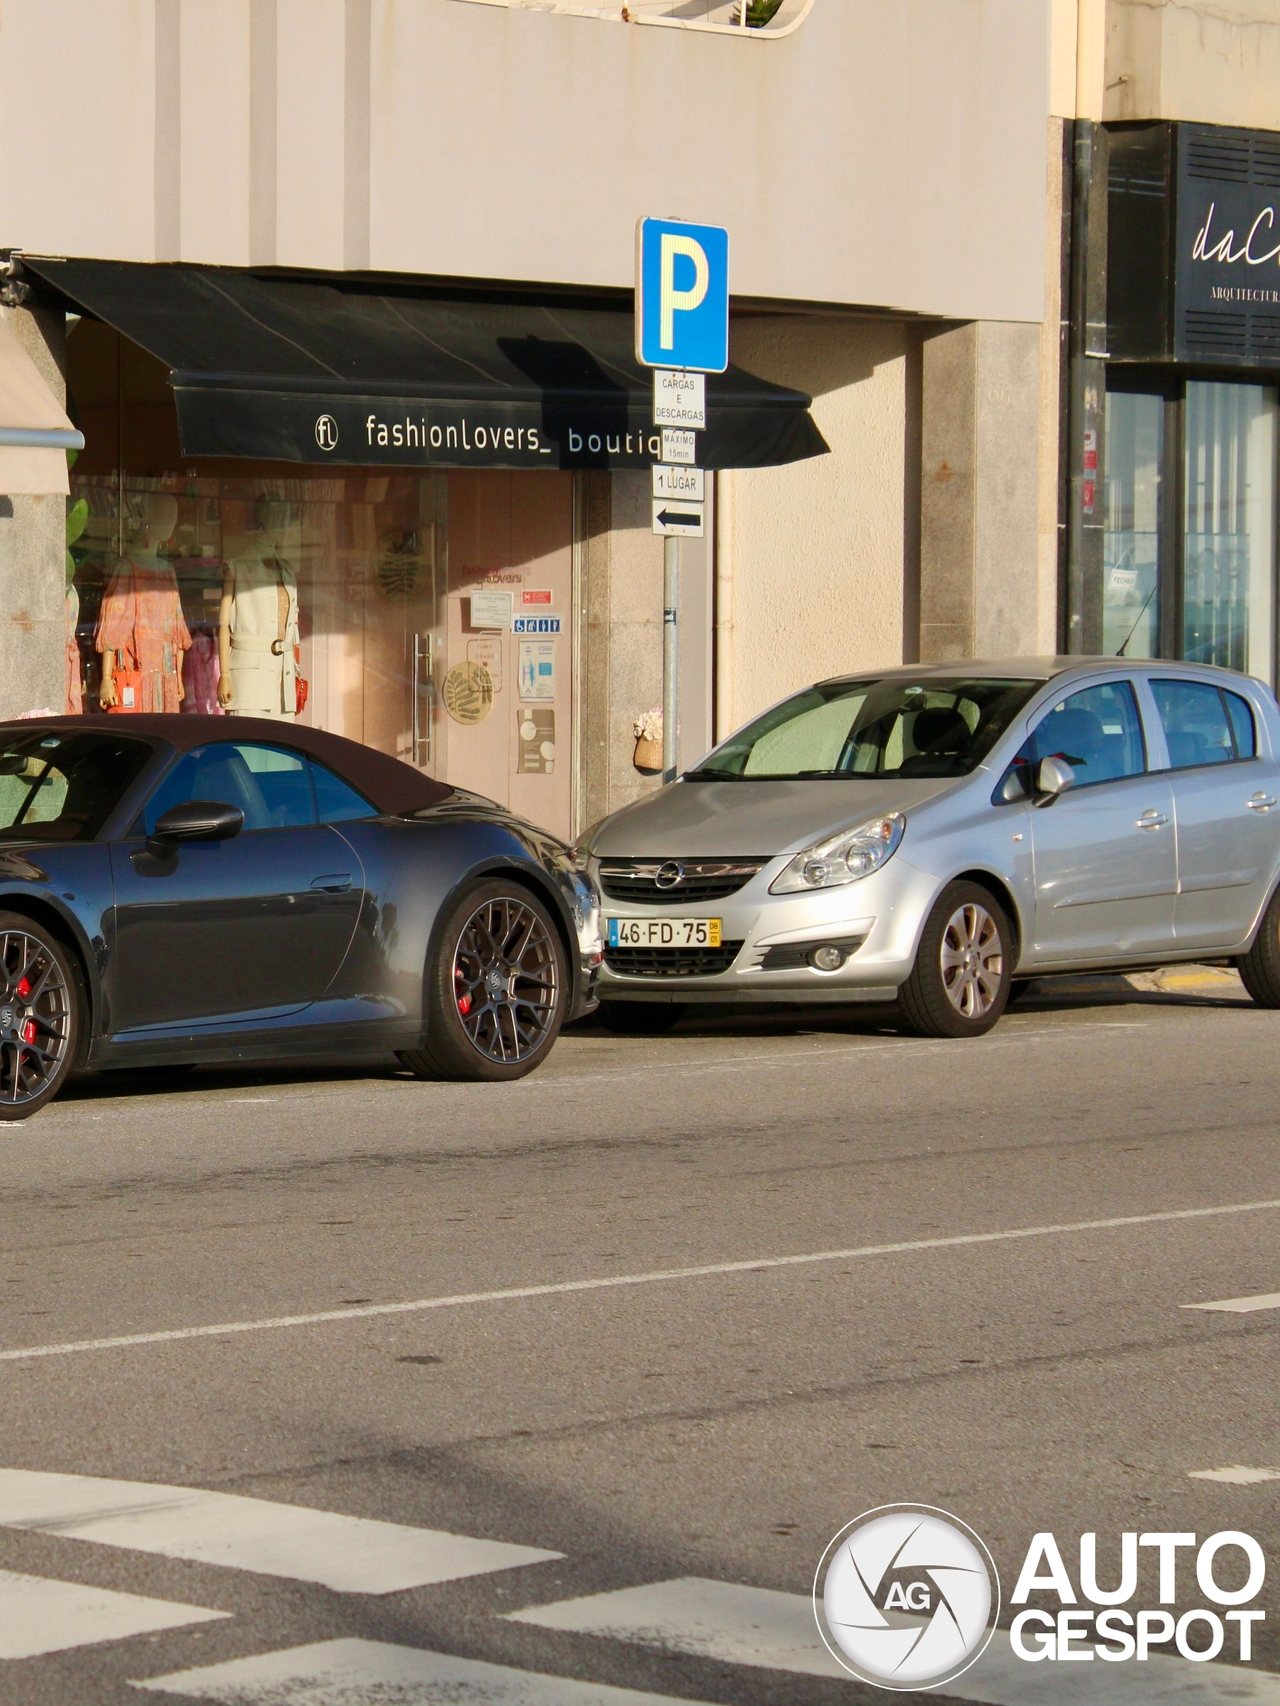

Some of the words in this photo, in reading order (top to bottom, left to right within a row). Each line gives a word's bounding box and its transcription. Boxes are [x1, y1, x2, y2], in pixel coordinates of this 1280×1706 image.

[1192, 202, 1280, 267] daC
[660, 233, 709, 350] P
[1210, 287, 1280, 303] ARQUITECTUR
[662, 378, 695, 390] CARGAS
[676, 394, 682, 404] E
[656, 407, 704, 421] DESCARGAS
[568, 428, 661, 460] boutiq
[658, 475, 664, 488] 1
[667, 475, 697, 491] LUGAR
[709, 922, 718, 930] 08
